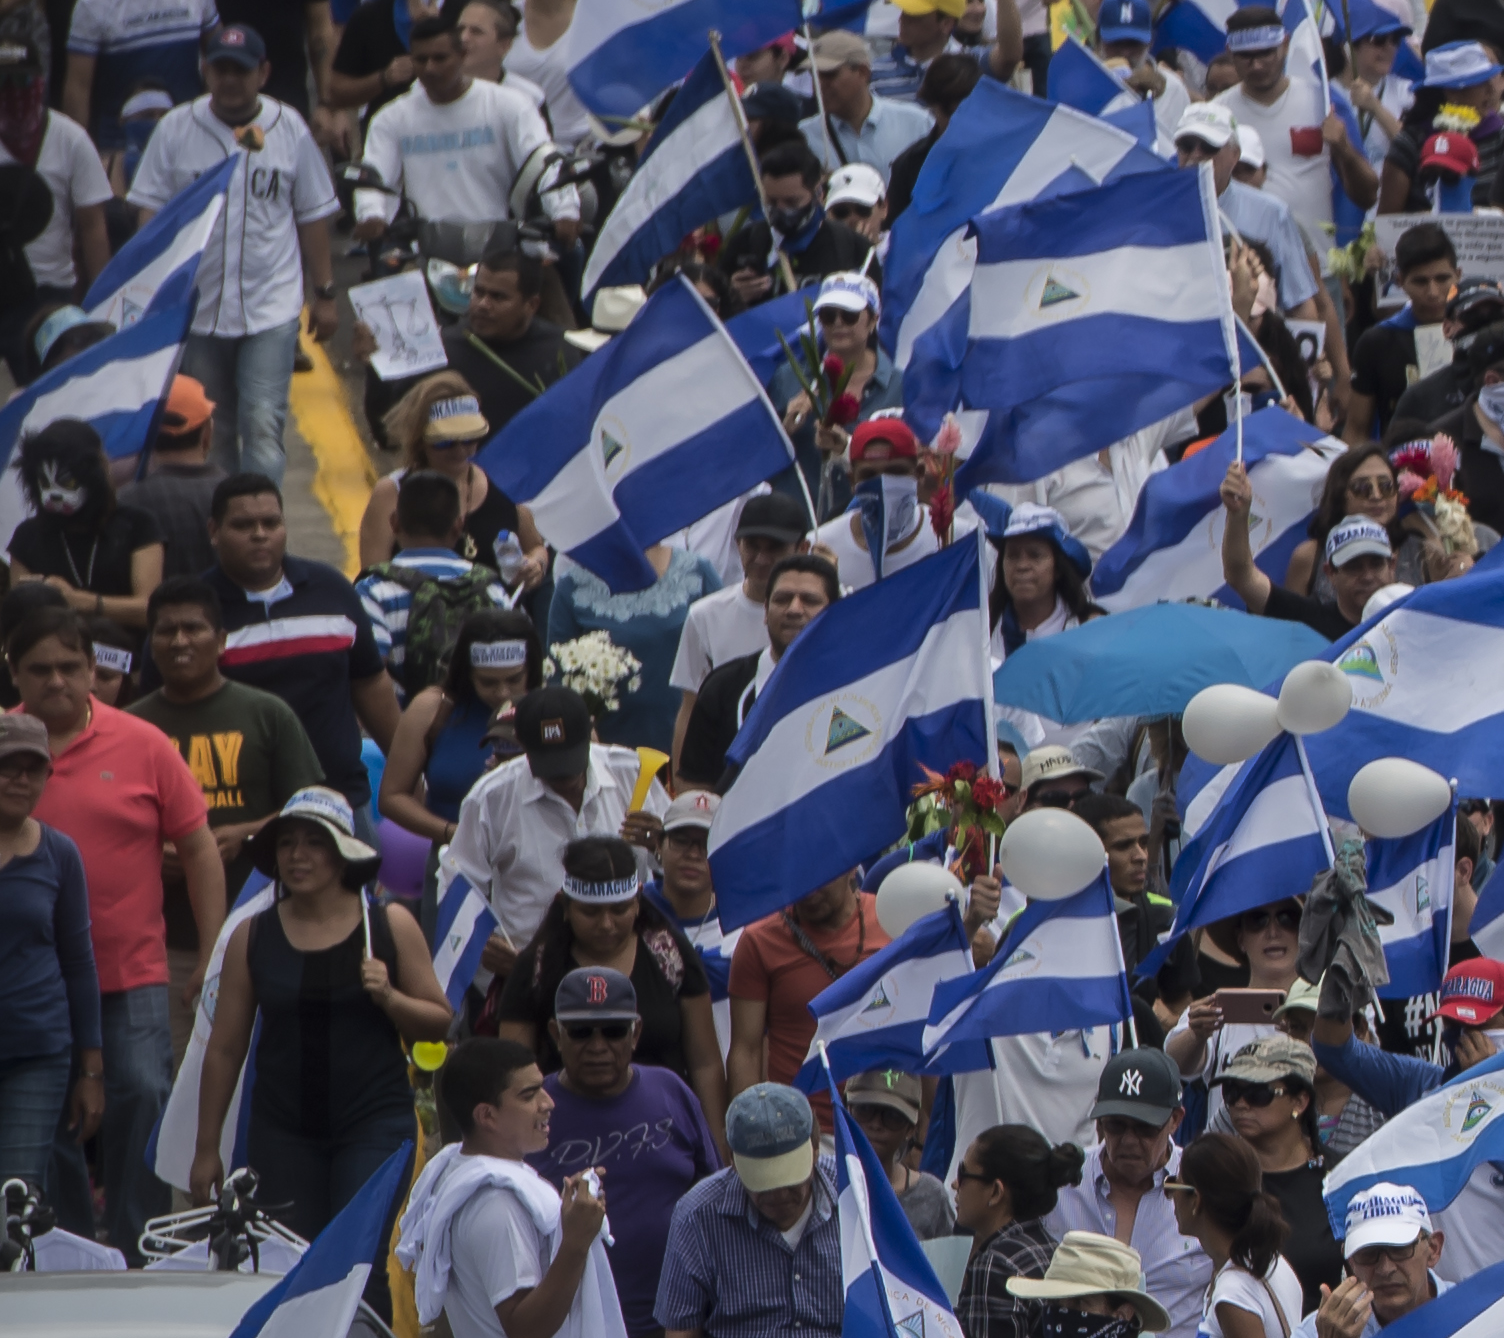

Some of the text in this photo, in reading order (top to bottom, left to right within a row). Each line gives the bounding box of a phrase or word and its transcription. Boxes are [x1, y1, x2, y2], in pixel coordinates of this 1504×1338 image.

[1119, 1, 1133, 23] N
[587, 976, 609, 1004] B
[1119, 1068, 1143, 1096] NY
